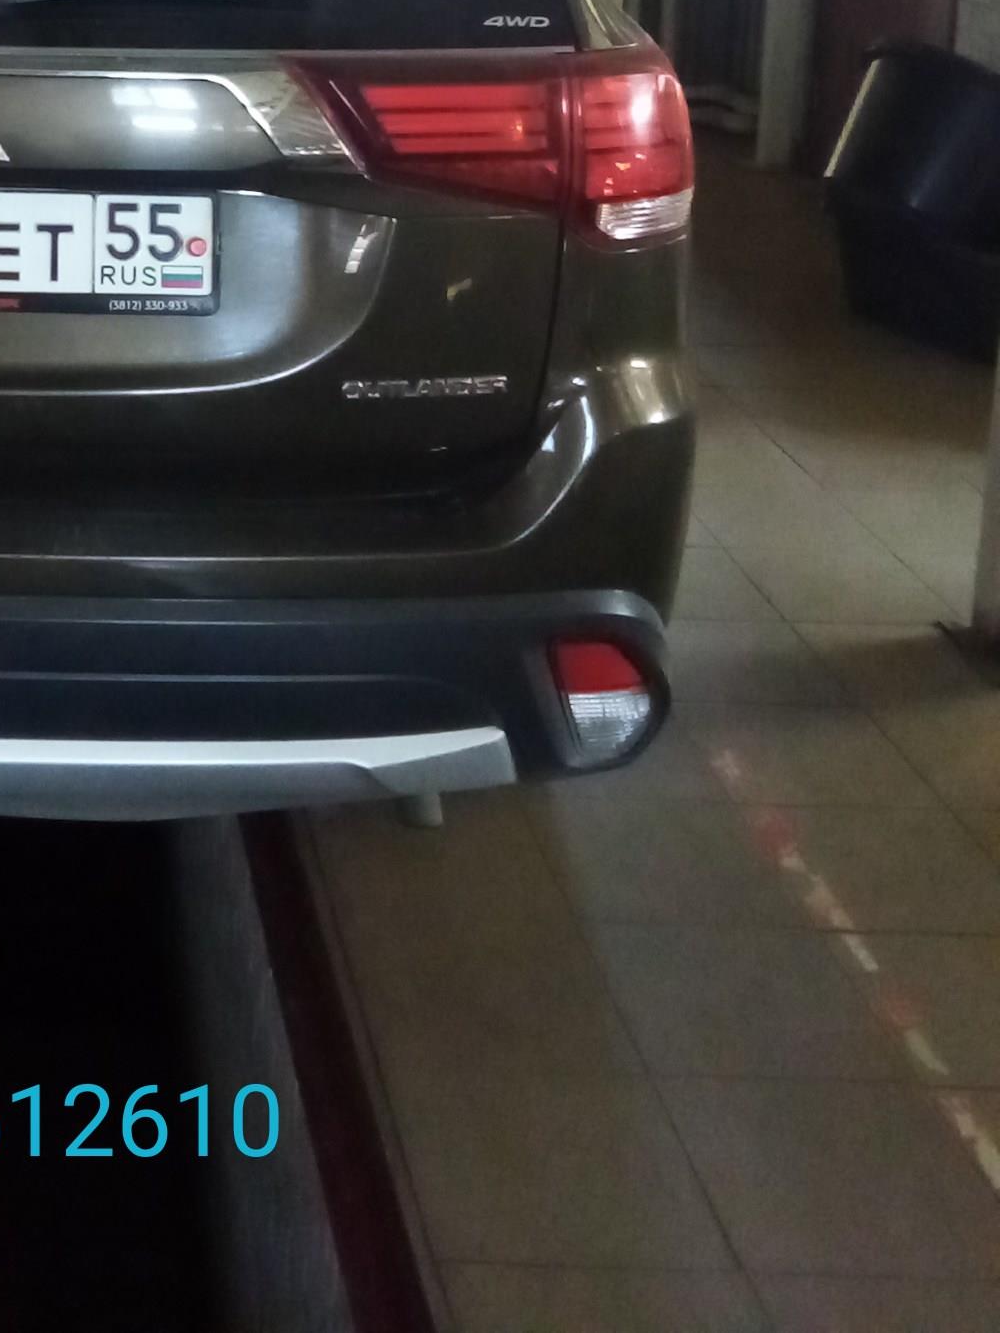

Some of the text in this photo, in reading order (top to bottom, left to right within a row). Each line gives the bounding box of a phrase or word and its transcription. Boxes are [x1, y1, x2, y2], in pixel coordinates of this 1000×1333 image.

[483, 15, 550, 27] 4WD
[107, 203, 184, 262] 55
[100, 265, 157, 286] RUS
[341, 376, 507, 399] OUTLANDER
